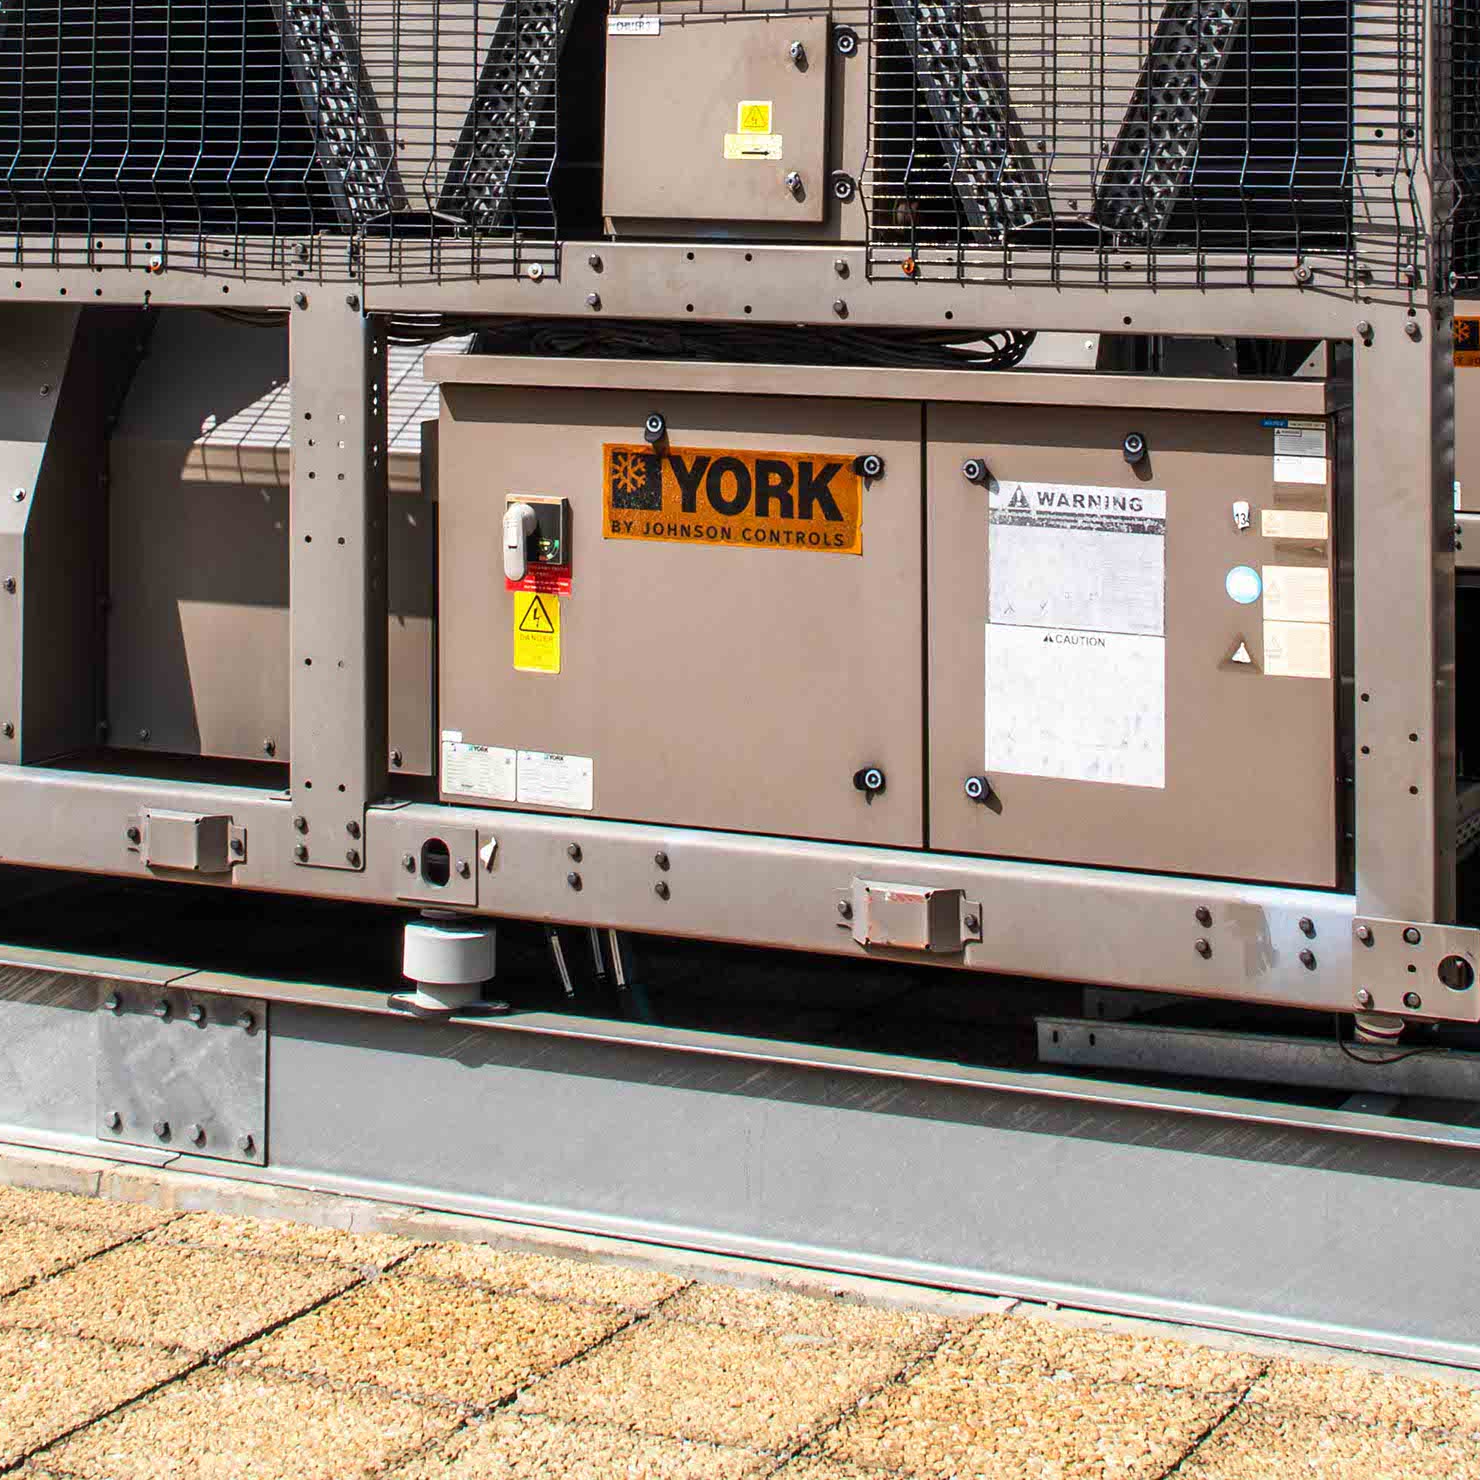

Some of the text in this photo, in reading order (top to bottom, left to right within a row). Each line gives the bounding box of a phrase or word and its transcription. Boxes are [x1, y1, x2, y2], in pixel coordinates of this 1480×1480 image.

[669, 455, 845, 521] YORK
[1037, 491, 1144, 512] WARNING
[611, 521, 845, 546] BY JOHNSON CONTROLS
[1055, 634, 1106, 647] CAUTION
